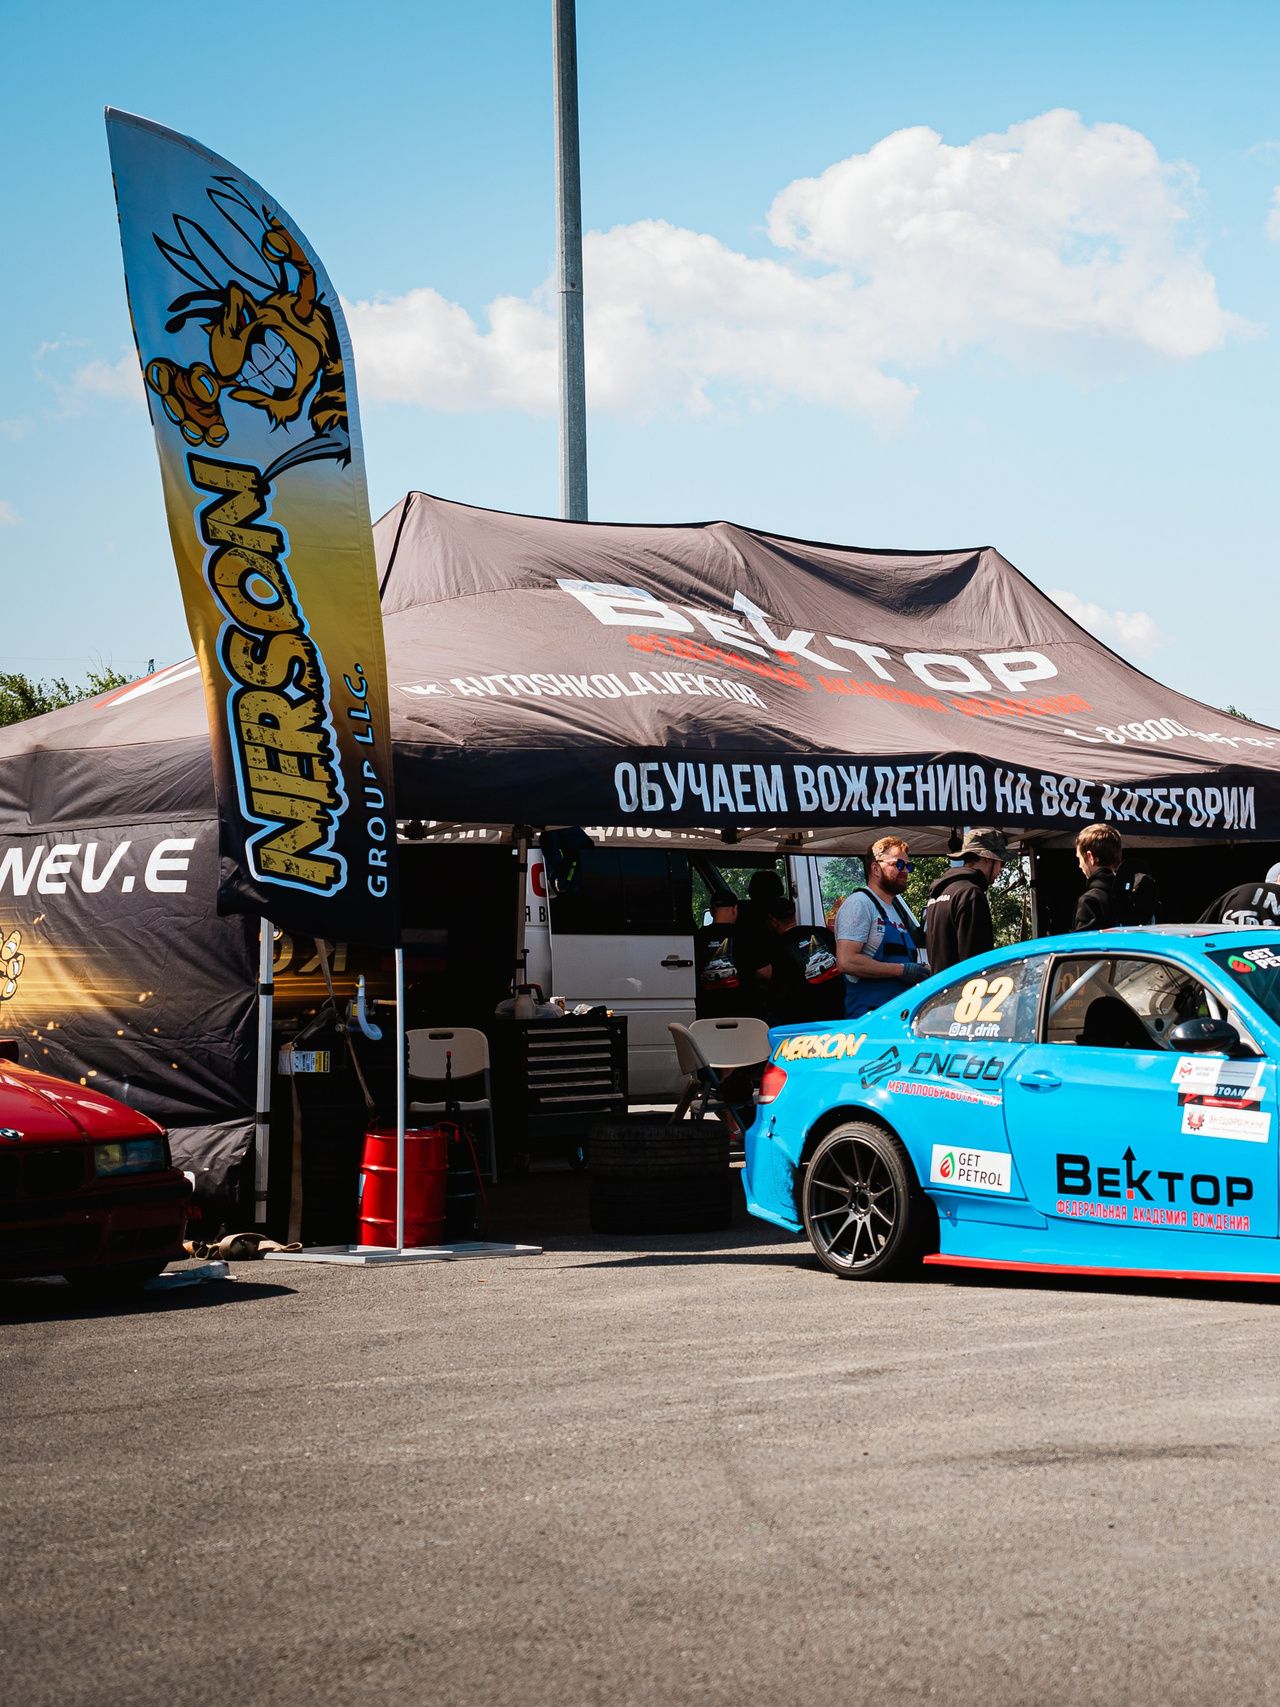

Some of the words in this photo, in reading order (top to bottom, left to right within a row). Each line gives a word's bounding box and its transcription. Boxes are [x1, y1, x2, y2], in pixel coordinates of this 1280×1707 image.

[191, 455, 344, 890] NERSON
[449, 671, 768, 709] AVTOSHKOLA.VEKTOR
[345, 664, 375, 746] LLC.
[614, 761, 789, 814] ОБУЧАЕМ
[800, 764, 987, 817] ВОЖДЕНИЮ
[994, 768, 1033, 817] НА
[1042, 774, 1095, 820] ВСЕ
[1100, 784, 1257, 831] КАТЕГОРИИ
[363, 760, 388, 897] GROUP
[1242, 947, 1276, 961] GET
[954, 976, 1014, 1023] 82
[774, 1033, 867, 1062] NERSON
[957, 1168, 1003, 1187] PETROL
[958, 1152, 981, 1168] GET
[1056, 1199, 1128, 1221] ФЕДЕРАЛЬНАЯ
[1133, 1207, 1187, 1226] АКАДЕМИЯ
[1193, 1211, 1250, 1232] ВОЖДЕНИЯ
